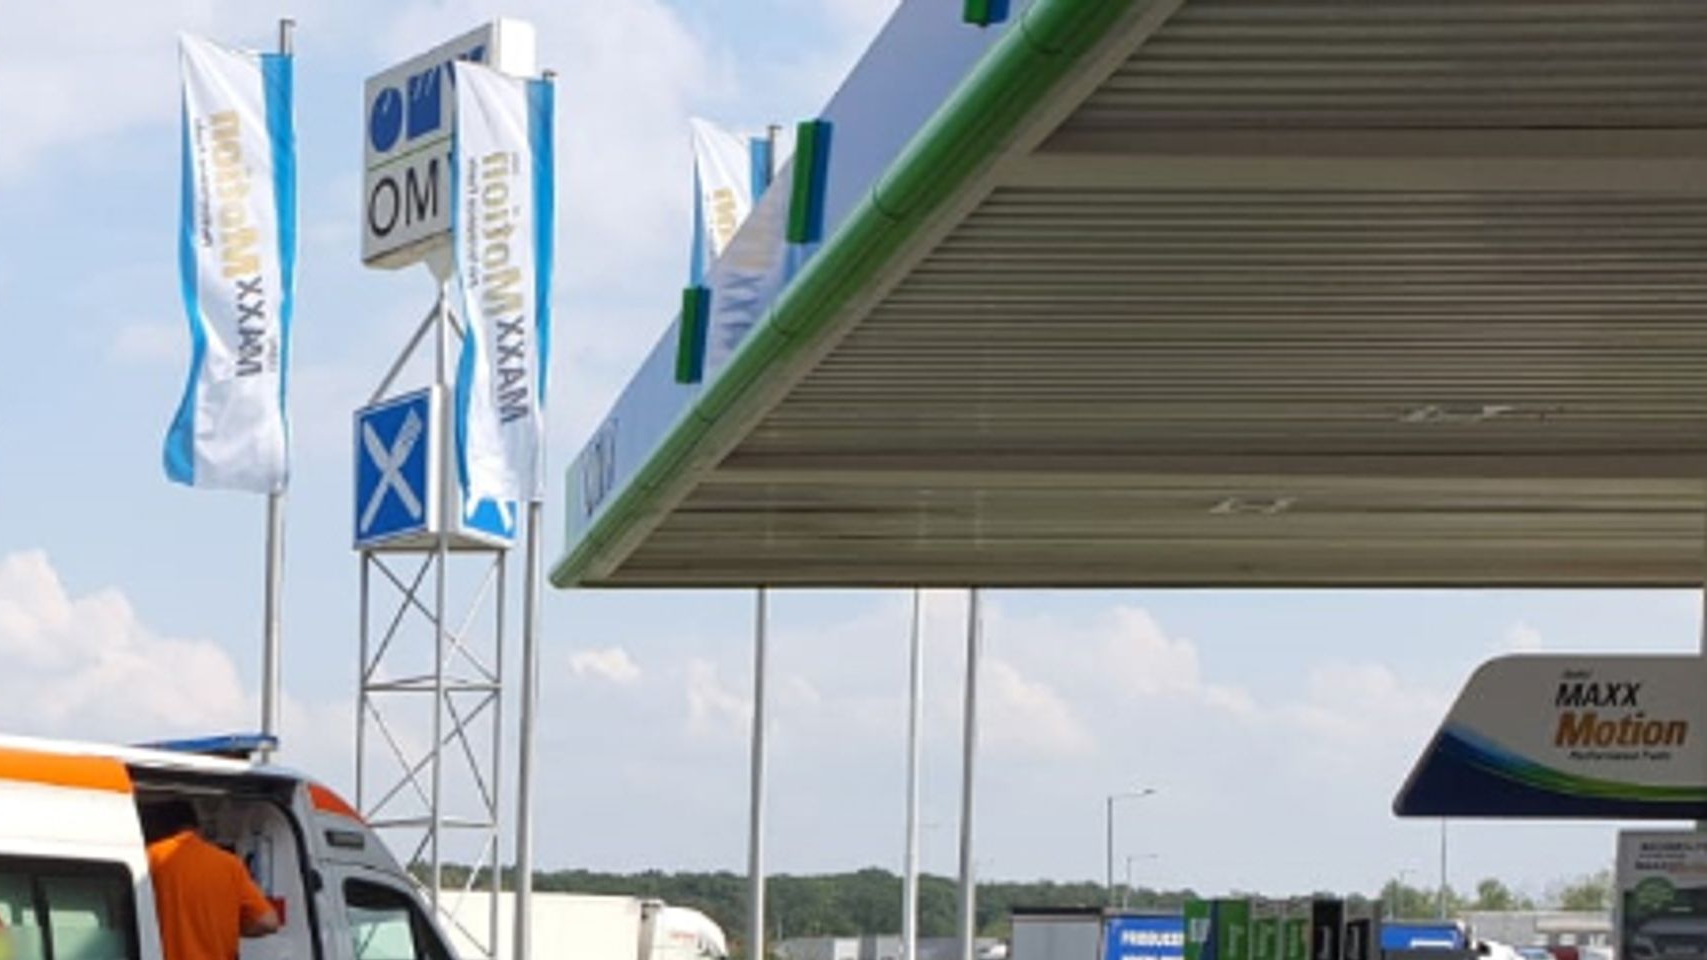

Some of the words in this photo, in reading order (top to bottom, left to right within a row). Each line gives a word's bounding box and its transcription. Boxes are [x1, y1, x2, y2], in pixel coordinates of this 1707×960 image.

[368, 153, 453, 237] OM
[1555, 683, 1641, 707] MAXX
[1554, 710, 1689, 747] Motion
